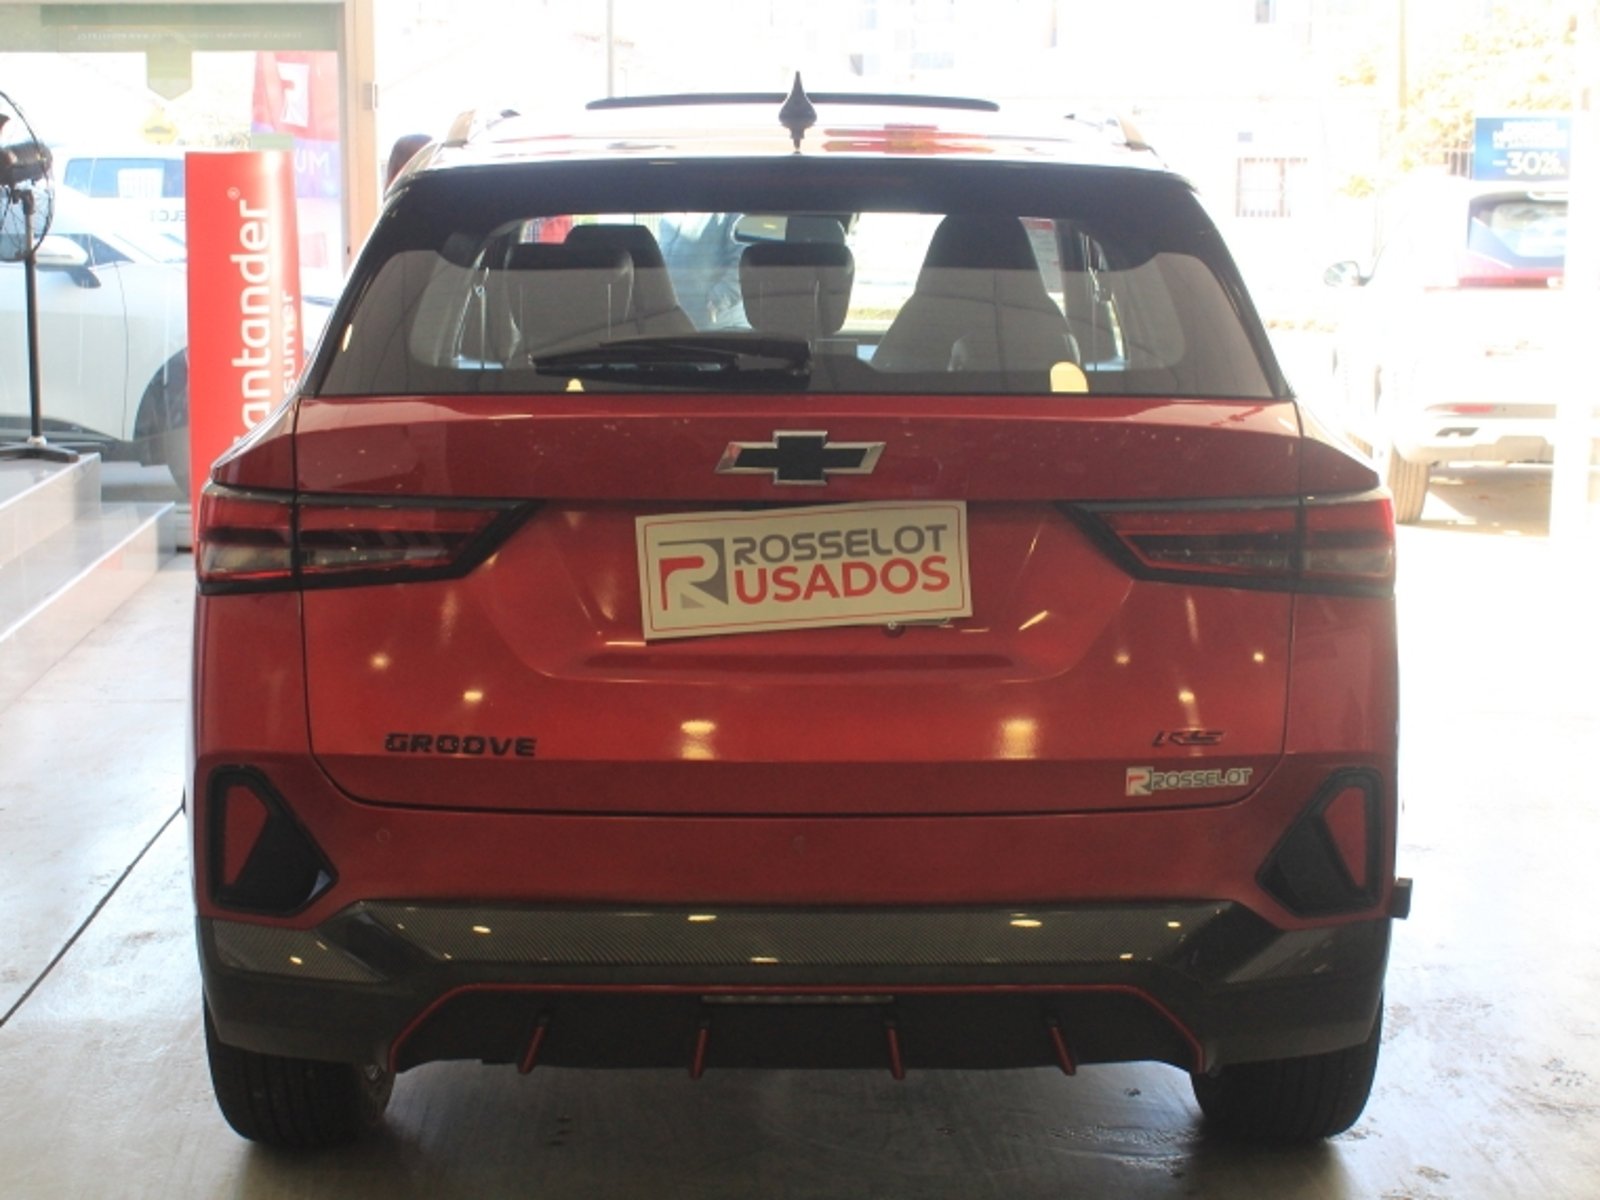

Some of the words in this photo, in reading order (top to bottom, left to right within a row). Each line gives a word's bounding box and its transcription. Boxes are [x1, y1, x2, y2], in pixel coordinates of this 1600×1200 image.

[229, 199, 272, 446] antander
[281, 290, 297, 397] sumer
[732, 524, 948, 566] ROSSELOT
[734, 555, 951, 605] USADOS
[384, 733, 538, 757] GROOVE
[1153, 767, 1252, 790] ROSSELOT
